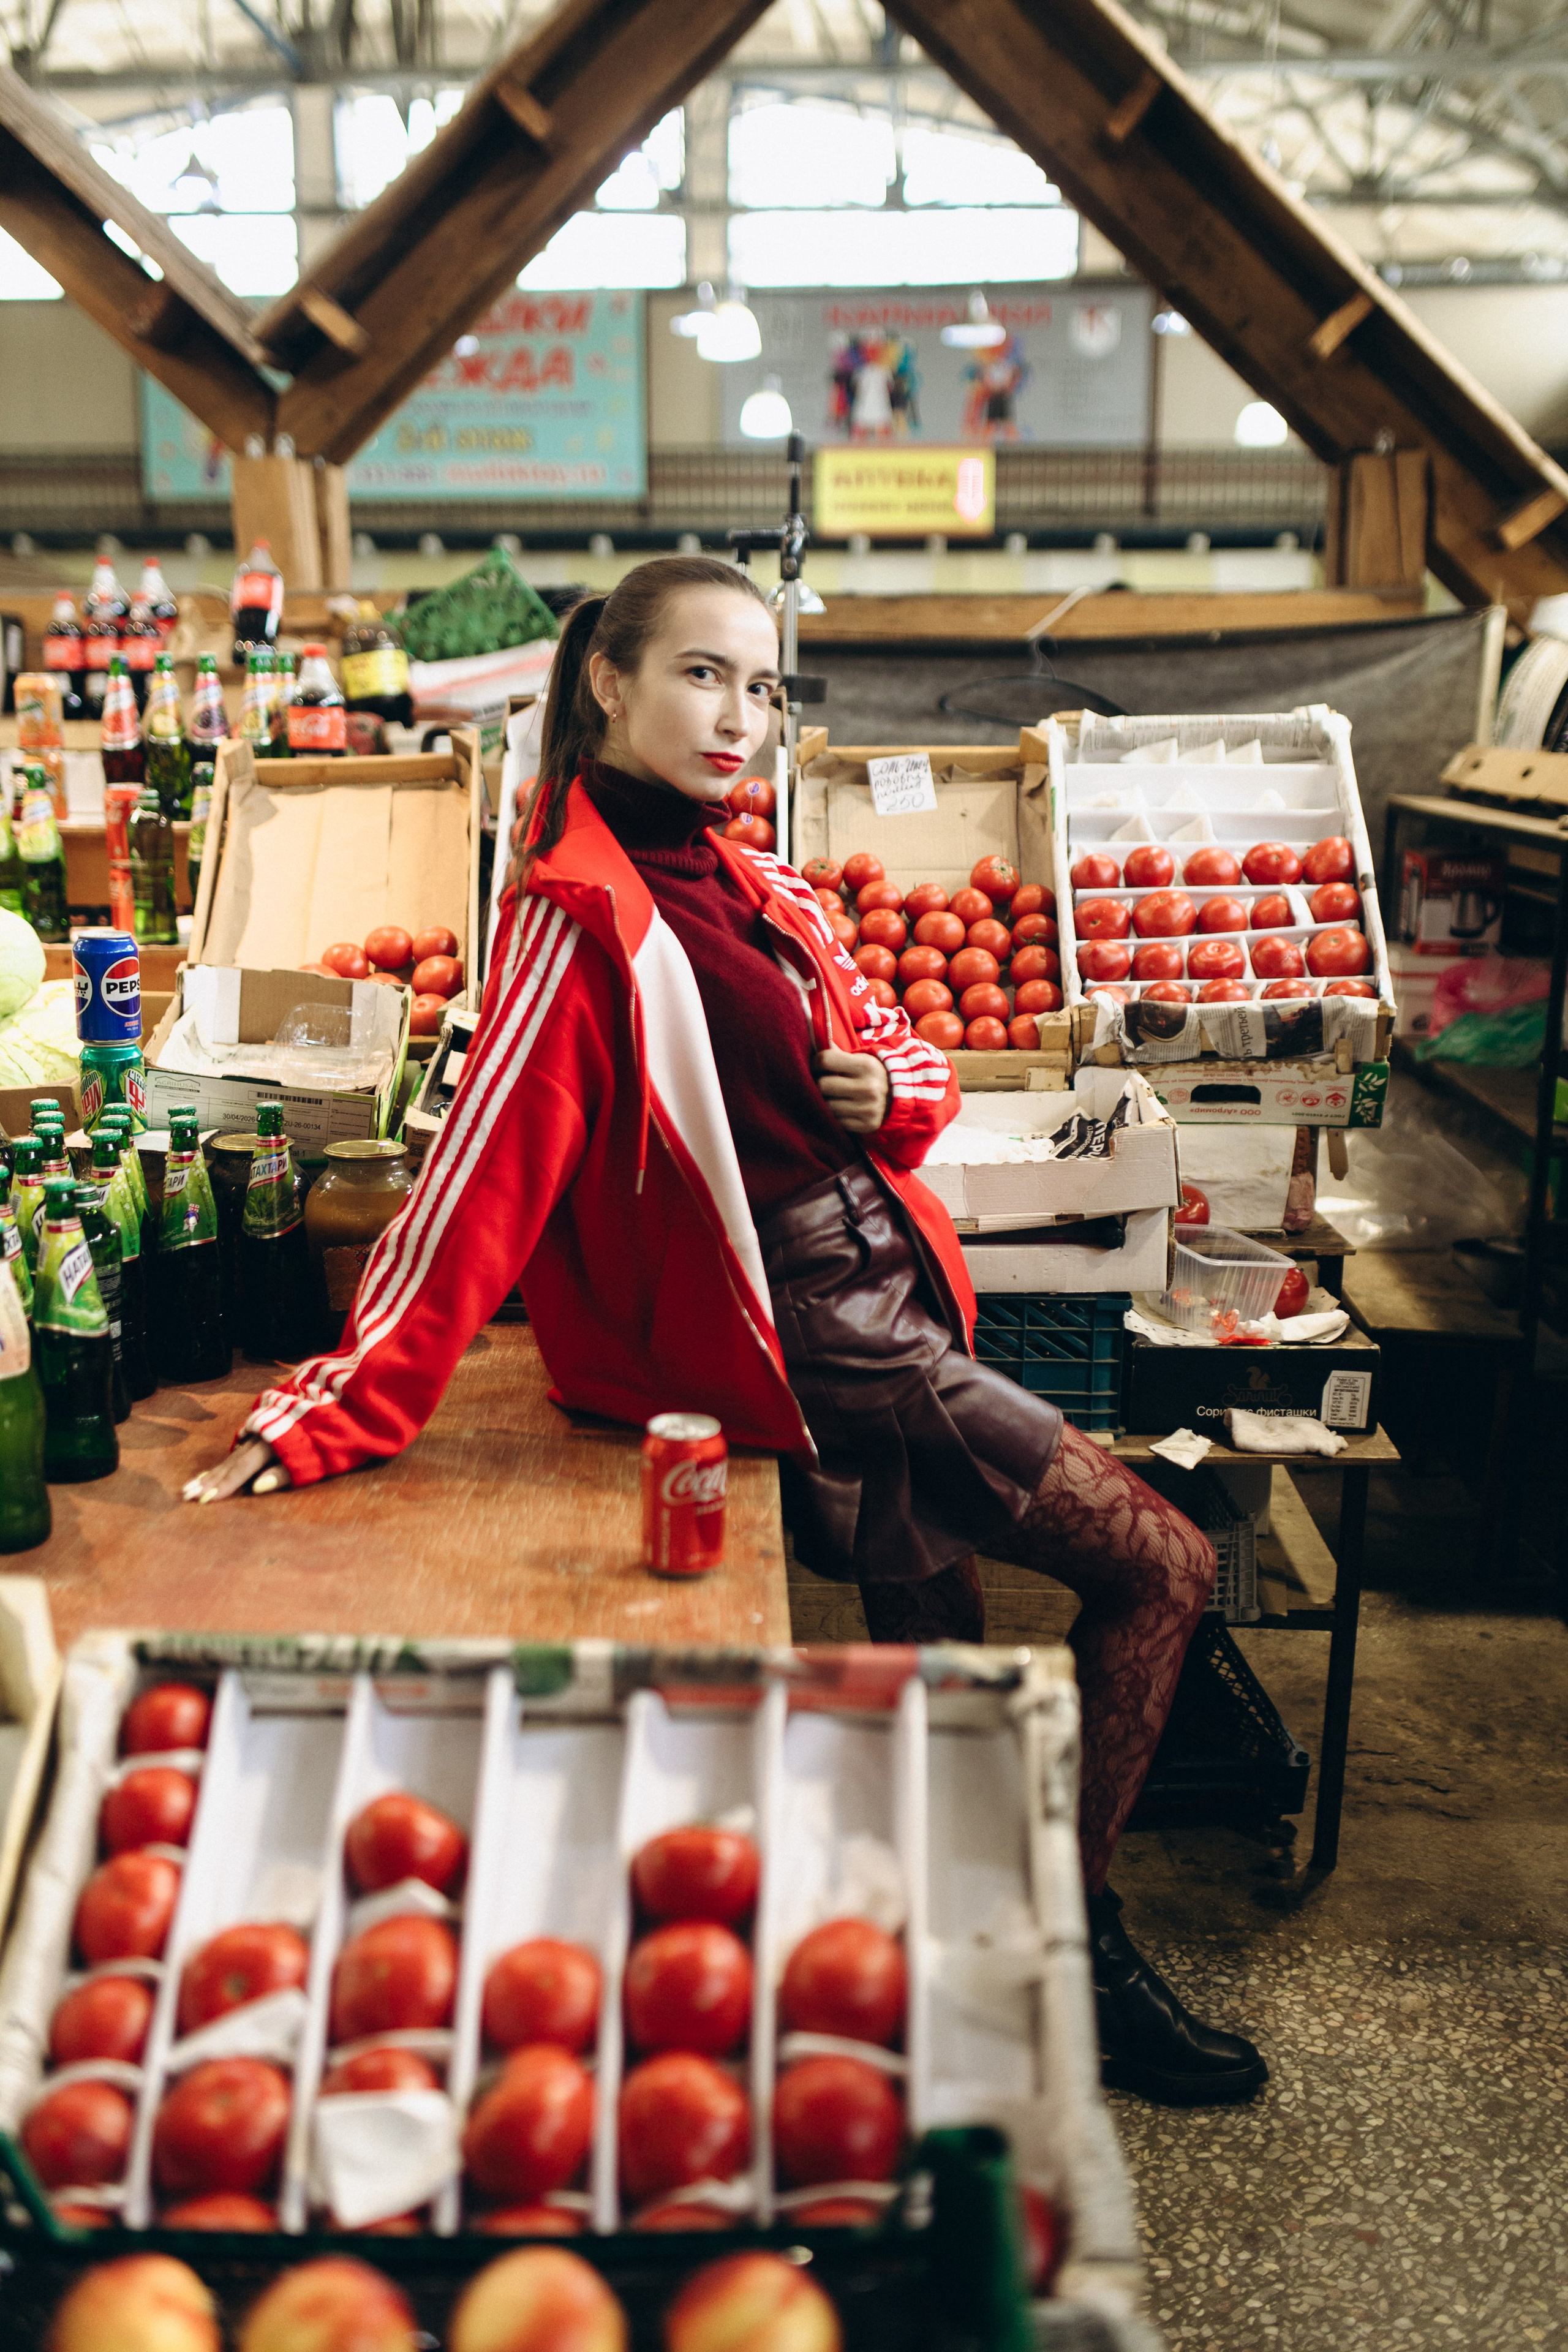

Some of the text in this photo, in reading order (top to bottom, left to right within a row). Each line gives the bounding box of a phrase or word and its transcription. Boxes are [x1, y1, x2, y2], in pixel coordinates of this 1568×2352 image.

[106, 979, 140, 994] PEPS
[1234, 1006, 1253, 1047] третьей
[156, 1080, 199, 1090] AGRIHUSAC
[223, 1113, 255, 1123] 30/04/2026
[250, 1156, 287, 1181] ТАХТАРИ
[63, 1253, 92, 1289] НАТА
[1256, 1407, 1317, 1417] фисташки
